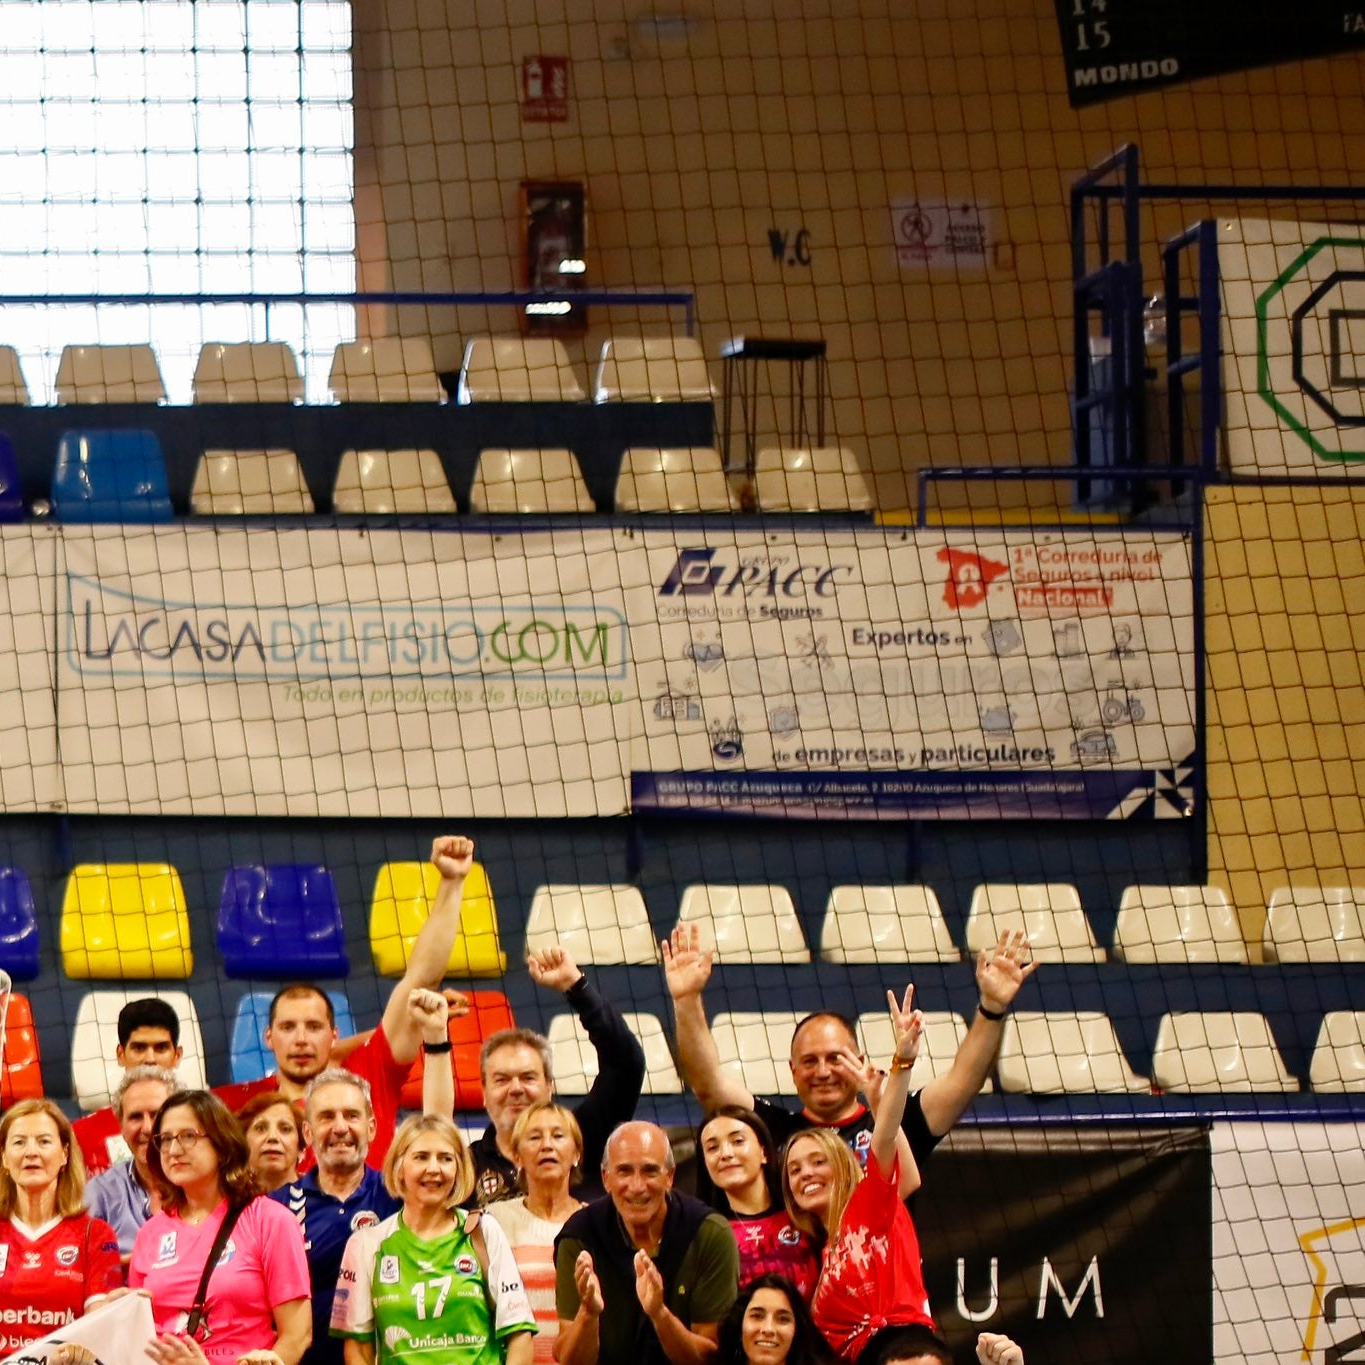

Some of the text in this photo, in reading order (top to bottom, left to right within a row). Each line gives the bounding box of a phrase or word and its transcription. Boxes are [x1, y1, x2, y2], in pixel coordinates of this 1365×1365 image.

[1077, 21, 1112, 50] 15
[1073, 57, 1180, 87] MONDO
[721, 564, 855, 598] PACC
[759, 604, 824, 621] Seguros
[84, 598, 610, 666] LACASADELFISIO.COM
[852, 628, 951, 649] Expertos
[794, 749, 905, 767] empresas
[920, 744, 1056, 767] particulares
[410, 1275, 453, 1321] 17
[408, 1332, 455, 1349] Unicaja
